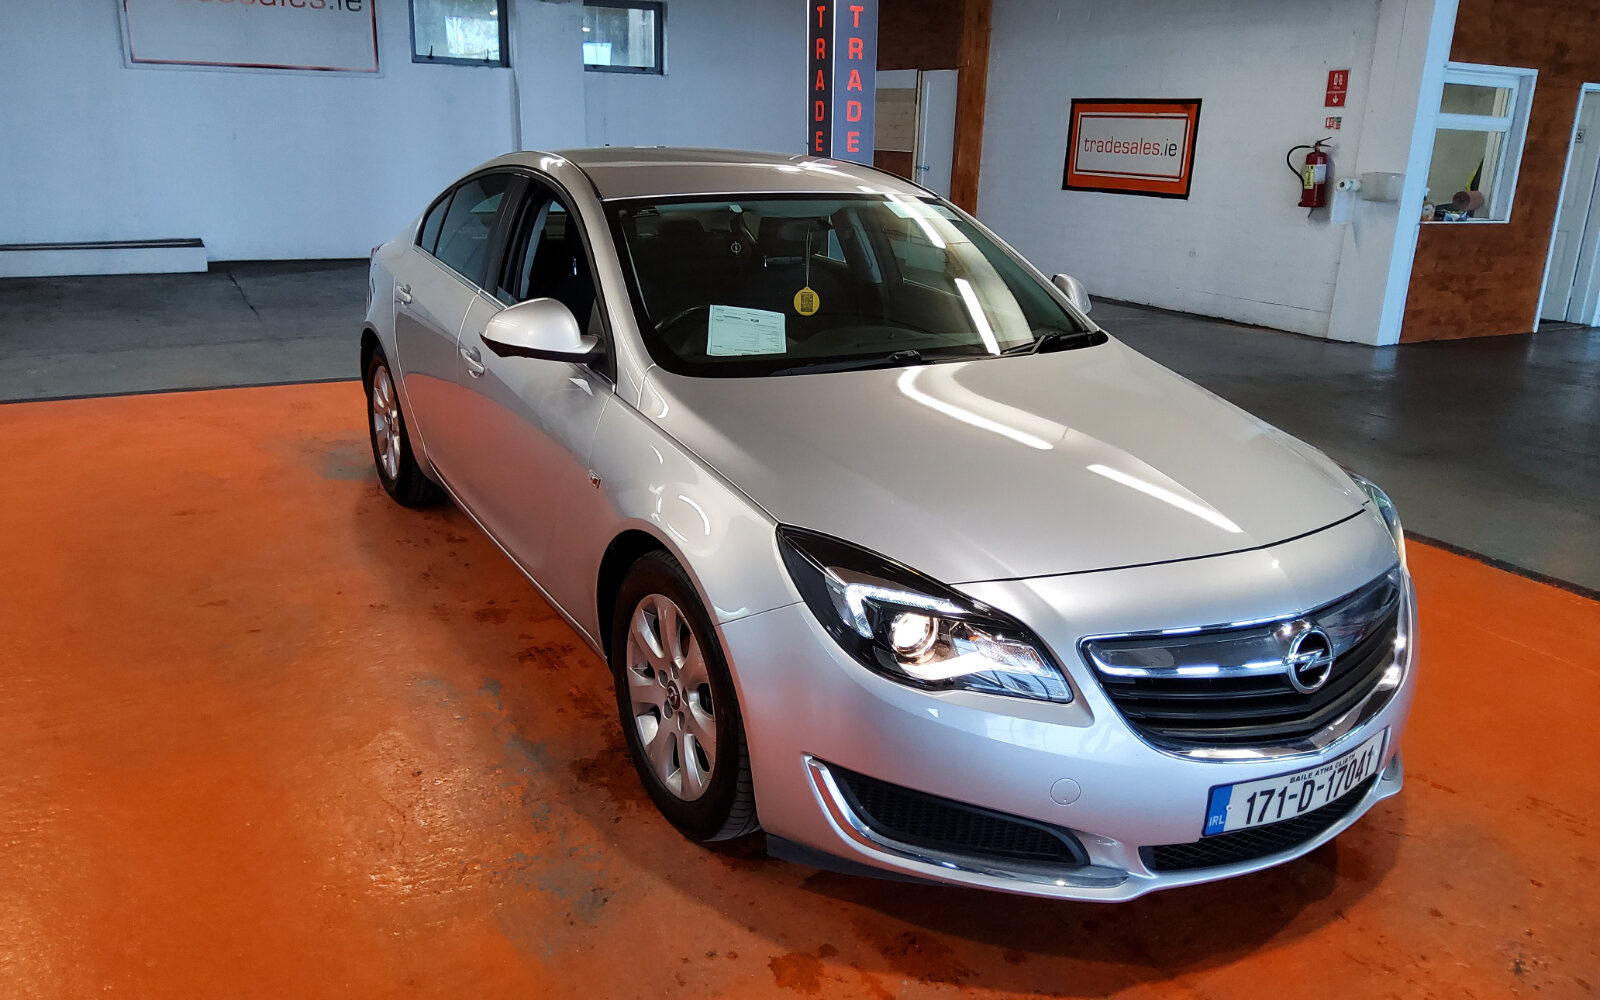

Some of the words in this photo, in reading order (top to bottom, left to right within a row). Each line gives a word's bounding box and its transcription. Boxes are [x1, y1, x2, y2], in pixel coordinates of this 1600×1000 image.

[815, 5, 826, 152] TRADE
[846, 5, 864, 152] TRADE
[1084, 136, 1178, 157] tradesales.ie
[1245, 745, 1374, 825] 171-D-17041
[1290, 772, 1313, 784] BAILE
[1208, 815, 1225, 827] IRL
